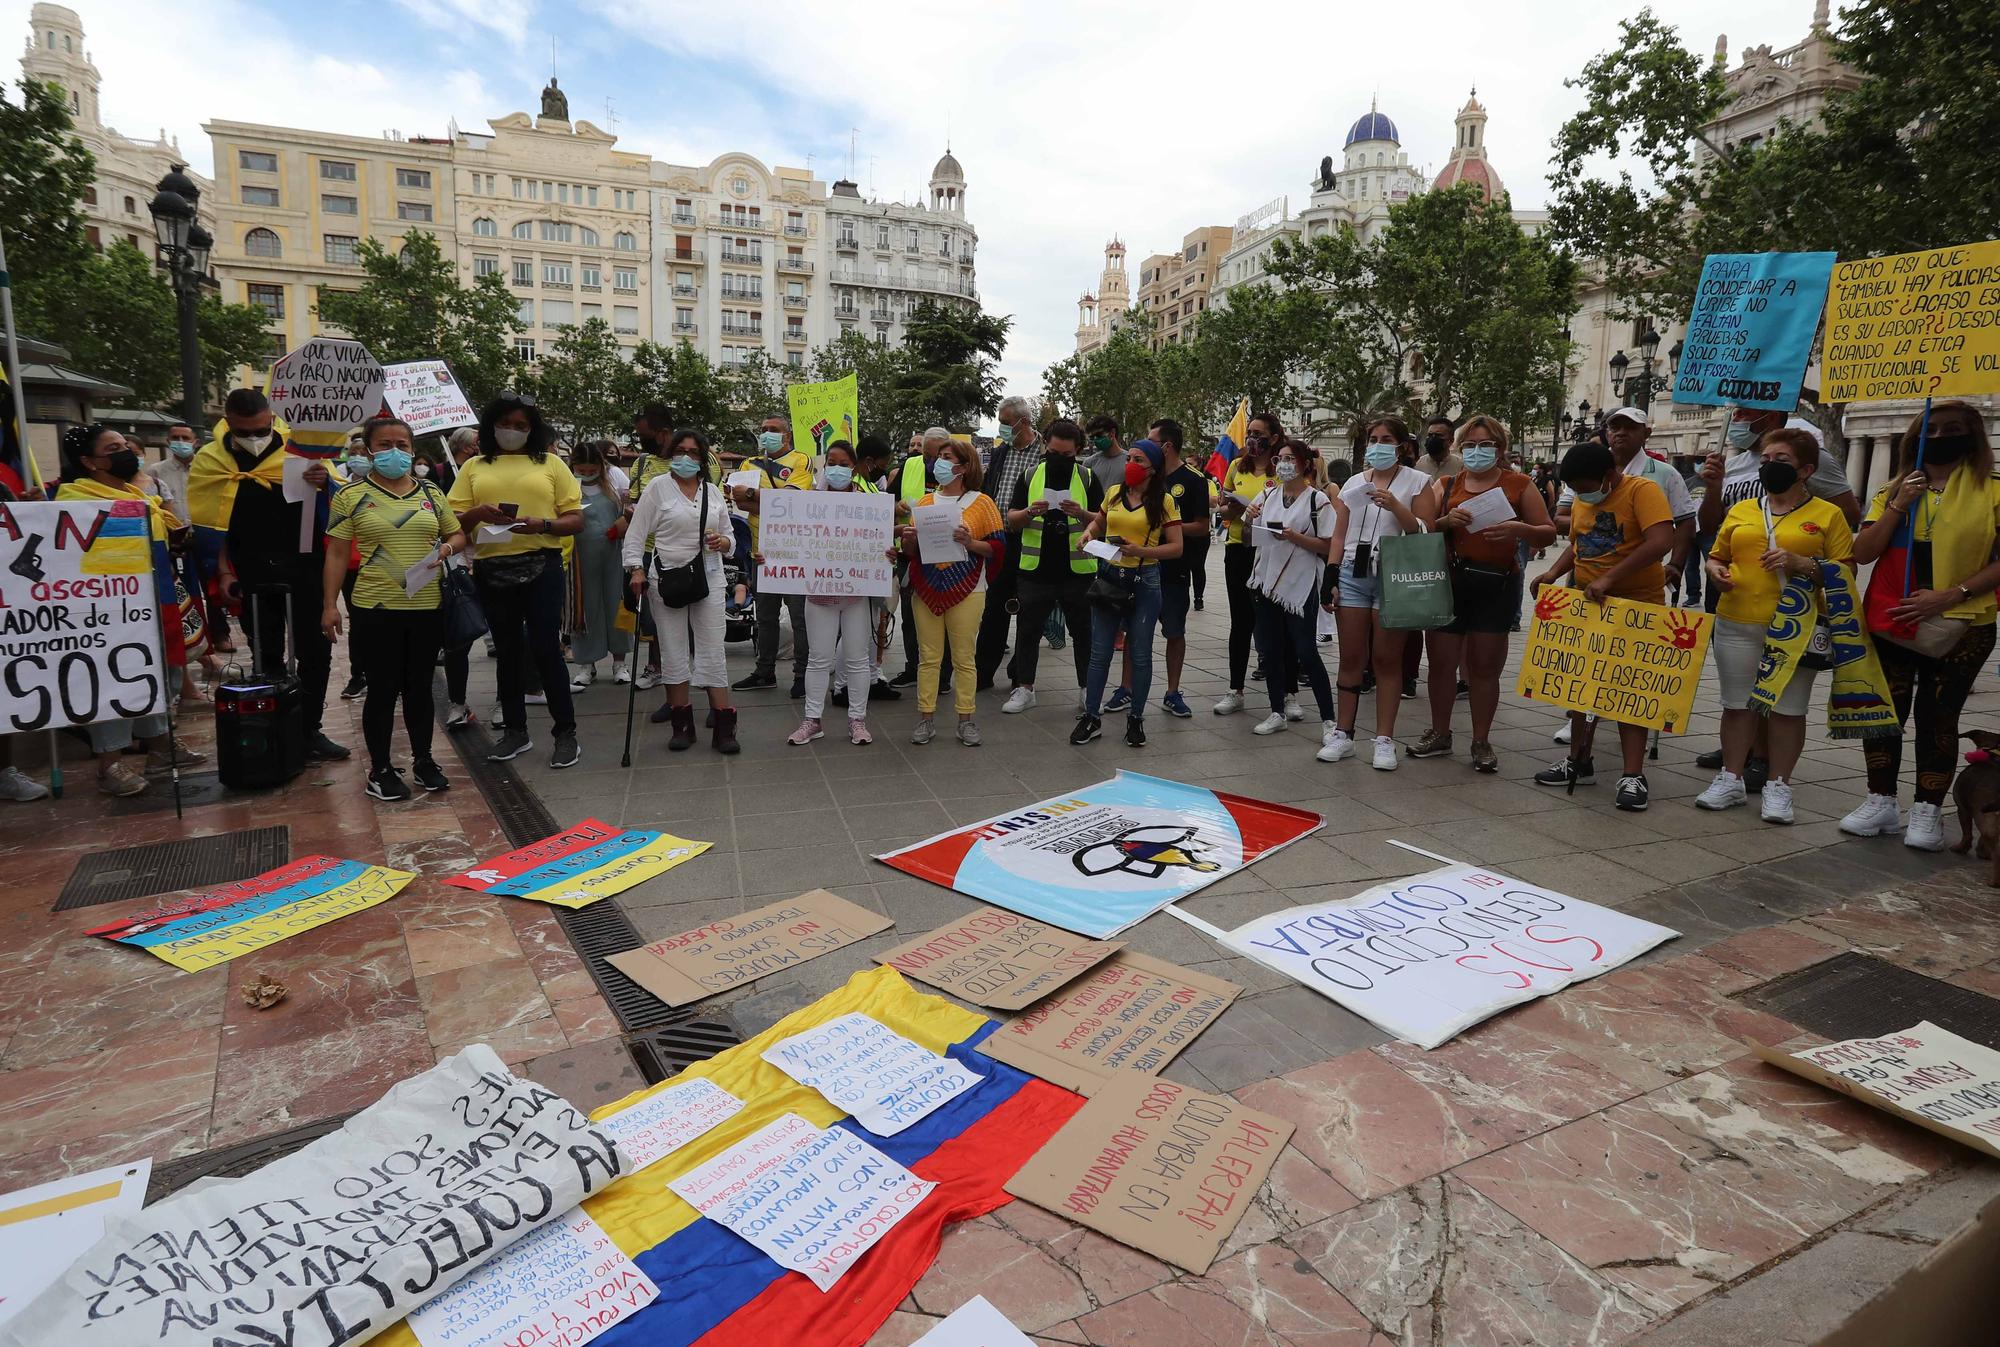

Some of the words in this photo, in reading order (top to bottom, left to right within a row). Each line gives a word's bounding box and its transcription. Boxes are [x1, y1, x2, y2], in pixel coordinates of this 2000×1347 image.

[1709, 261, 1750, 278] PARA
[1893, 257, 1920, 274] ASI
[1927, 251, 1970, 269] QUE:
[1702, 279, 1777, 296] CONDENAR
[1780, 279, 1797, 296] A
[1903, 274, 1935, 292] HAY
[1698, 297, 1741, 312] URIBE
[1745, 298, 1768, 313] NO
[1694, 314, 1742, 328] FALTAN
[1833, 325, 1849, 340] ES
[1855, 324, 1874, 339] SU
[1691, 329, 1748, 345] PRUEBAS
[1830, 343, 1884, 361] CUANDO
[1894, 341, 1912, 355] LA
[1920, 335, 1965, 353] ETICA
[303, 343, 330, 361] QUE
[335, 345, 373, 365] VIVA
[1687, 345, 1718, 360] SOLO
[1721, 348, 1761, 362] FALTA
[276, 362, 295, 380] EL
[300, 363, 333, 382] PARO
[1684, 363, 1701, 375] UN
[1704, 364, 1738, 378] FISCAL
[1829, 360, 1928, 380] INSTITUCIONAL
[1940, 355, 1962, 374] SE
[323, 385, 367, 400] ESTAN
[1679, 377, 1705, 392] CON
[1831, 384, 1858, 399] UNA
[285, 404, 363, 423] MATANDO
[798, 398, 807, 406] NO
[806, 503, 828, 519] UN
[835, 504, 890, 520] PUEBLO
[766, 524, 831, 537] PROTESTA
[835, 526, 848, 537] EN
[763, 566, 805, 579] MATA
[814, 568, 844, 578] MAS
[849, 568, 869, 579] QUE
[874, 569, 887, 581] EL
[1391, 571, 1446, 582] PULL&BEAR
[30, 574, 139, 602] asesino
[0, 606, 77, 636] ADOR
[84, 603, 110, 628] de
[122, 598, 152, 624] los
[1570, 598, 1590, 618] SE
[1600, 606, 1617, 623] VE
[1625, 609, 1657, 630] QUE
[1536, 621, 1585, 648] MATAR
[1588, 633, 1605, 654] NO
[1609, 637, 1626, 657] ES
[1633, 641, 1691, 670] PECADO
[1532, 645, 1585, 676] CUANDO
[1592, 660, 1607, 681] EL
[1610, 664, 1681, 696] ASESINO
[4, 643, 158, 731] SOS
[1541, 673, 1563, 698] ES
[1567, 680, 1587, 705] EL
[1593, 688, 1659, 719] ESTADO
[1829, 710, 1894, 722] COLOMBIA
[968, 798, 1089, 841] PRESENTE
[1462, 874, 1505, 889] EN
[286, 877, 409, 928] VIVIENDO
[720, 906, 810, 942] TERRITORIO
[788, 920, 821, 936] NO
[1250, 885, 1467, 956] COLOMBIA
[238, 931, 279, 947] EN
[645, 920, 735, 957] GUERRA
[683, 943, 713, 956] DE
[713, 935, 778, 964] SOMOS
[798, 928, 854, 950] LAS
[1011, 941, 1065, 959] EL
[1310, 890, 1564, 991] GENOCIDIO
[180, 950, 233, 962] EL
[928, 944, 1005, 983] NUESTRA
[1052, 945, 1110, 970] SOS
[698, 949, 800, 988] MUJERES
[964, 962, 1030, 995] VOTO
[1127, 974, 1149, 986] LA
[1153, 978, 1169, 987] A
[1069, 985, 1103, 1007] VIOLA
[1095, 989, 1135, 1017] FUERZA
[1115, 988, 1160, 1023] COLOMBIA
[1172, 986, 1197, 1004] NO
[1010, 998, 1066, 1036] TORTURA
[1061, 1009, 1079, 1017] Y
[1149, 1001, 1181, 1025] PUEDO
[1177, 994, 1225, 1033] MINISTRO
[829, 1023, 849, 1036] NO
[1082, 1025, 1122, 1057] PORQUE
[1157, 1029, 1182, 1046] DEL
[835, 1035, 865, 1055] QUE
[1102, 1025, 1155, 1068] RETORNAR
[802, 1052, 834, 1071] HOY
[861, 1042, 917, 1075] NUESTRA
[825, 1074, 857, 1092] VOZ
[835, 1086, 865, 1103] CON
[883, 1074, 965, 1123] COLOMBIA
[1135, 1083, 1183, 1121] CRISIS
[746, 1117, 806, 1154] CRISTINA
[846, 1139, 862, 1155] SI
[1143, 1098, 1232, 1184] COLOMBIA
[681, 1154, 746, 1195] BAUTISTA
[824, 1152, 845, 1174] NO
[839, 1156, 883, 1193] NOS
[1061, 1123, 1149, 1215] HUMANITARIA
[740, 1173, 817, 1238] HABLAMOS
[1118, 1184, 1170, 1222] EN
[771, 1196, 837, 1250] MATAN
[793, 1195, 877, 1264] HABLAMOS
[594, 1238, 609, 1250] 16
[806, 1205, 899, 1273] COLOMBIA
[538, 1250, 592, 1282] VICTIMAS
[517, 1282, 535, 1294] DE
[518, 1272, 537, 1284] POR
[531, 1267, 587, 1300] POLICIAL
[552, 1274, 593, 1300] CASOS
[573, 1270, 637, 1309] VIOLA
[471, 1283, 511, 1309] PARTE
[530, 1299, 550, 1313] DE
[622, 1283, 651, 1307] LA
[440, 1294, 517, 1340] VIOLENCIA
[440, 1312, 462, 1325] DE
[551, 1312, 570, 1330] Y
